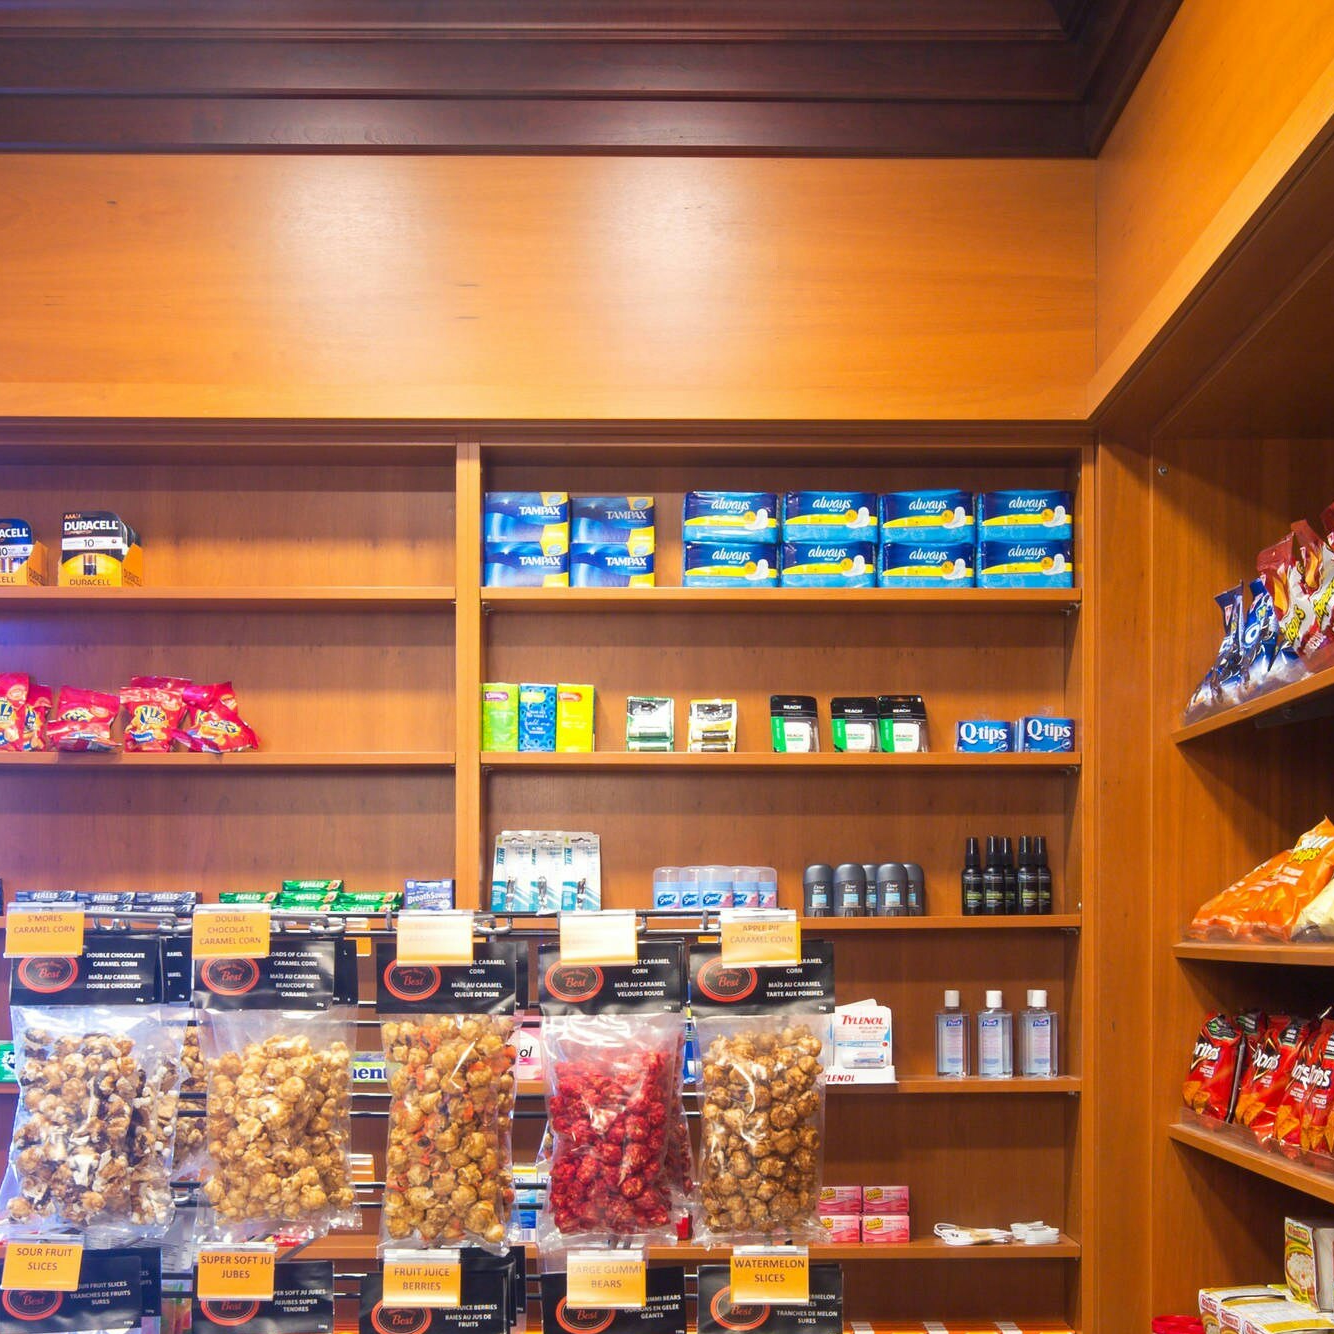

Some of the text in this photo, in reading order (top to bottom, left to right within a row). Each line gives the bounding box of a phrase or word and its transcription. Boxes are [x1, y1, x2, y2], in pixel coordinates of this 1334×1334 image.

[813, 497, 851, 510] always
[1009, 497, 1047, 510] always
[519, 506, 560, 516] TAMPAX
[64, 520, 118, 531] DURACELL
[84, 539, 93, 547] 10
[808, 546, 847, 559] always
[1009, 546, 1046, 559] always
[519, 556, 561, 566] TAMPAX
[605, 557, 647, 566] TAMPAX
[215, 915, 246, 923] DOUBLE
[200, 937, 236, 945] CARAMEL
[842, 1015, 883, 1025] TYLENOL
[17, 1248, 71, 1256] SOUR FRUIT
[201, 1256, 271, 1265] SUPER SOFT JU
[734, 1260, 804, 1268] WATERMELON
[28, 1262, 57, 1270] SLICES
[222, 1270, 250, 1278] JUBES
[395, 1268, 450, 1277] FRUIT JUICE
[755, 1274, 785, 1282] SLICES
[403, 1280, 441, 1290] BERRIES
[592, 1280, 622, 1288] BEARS
